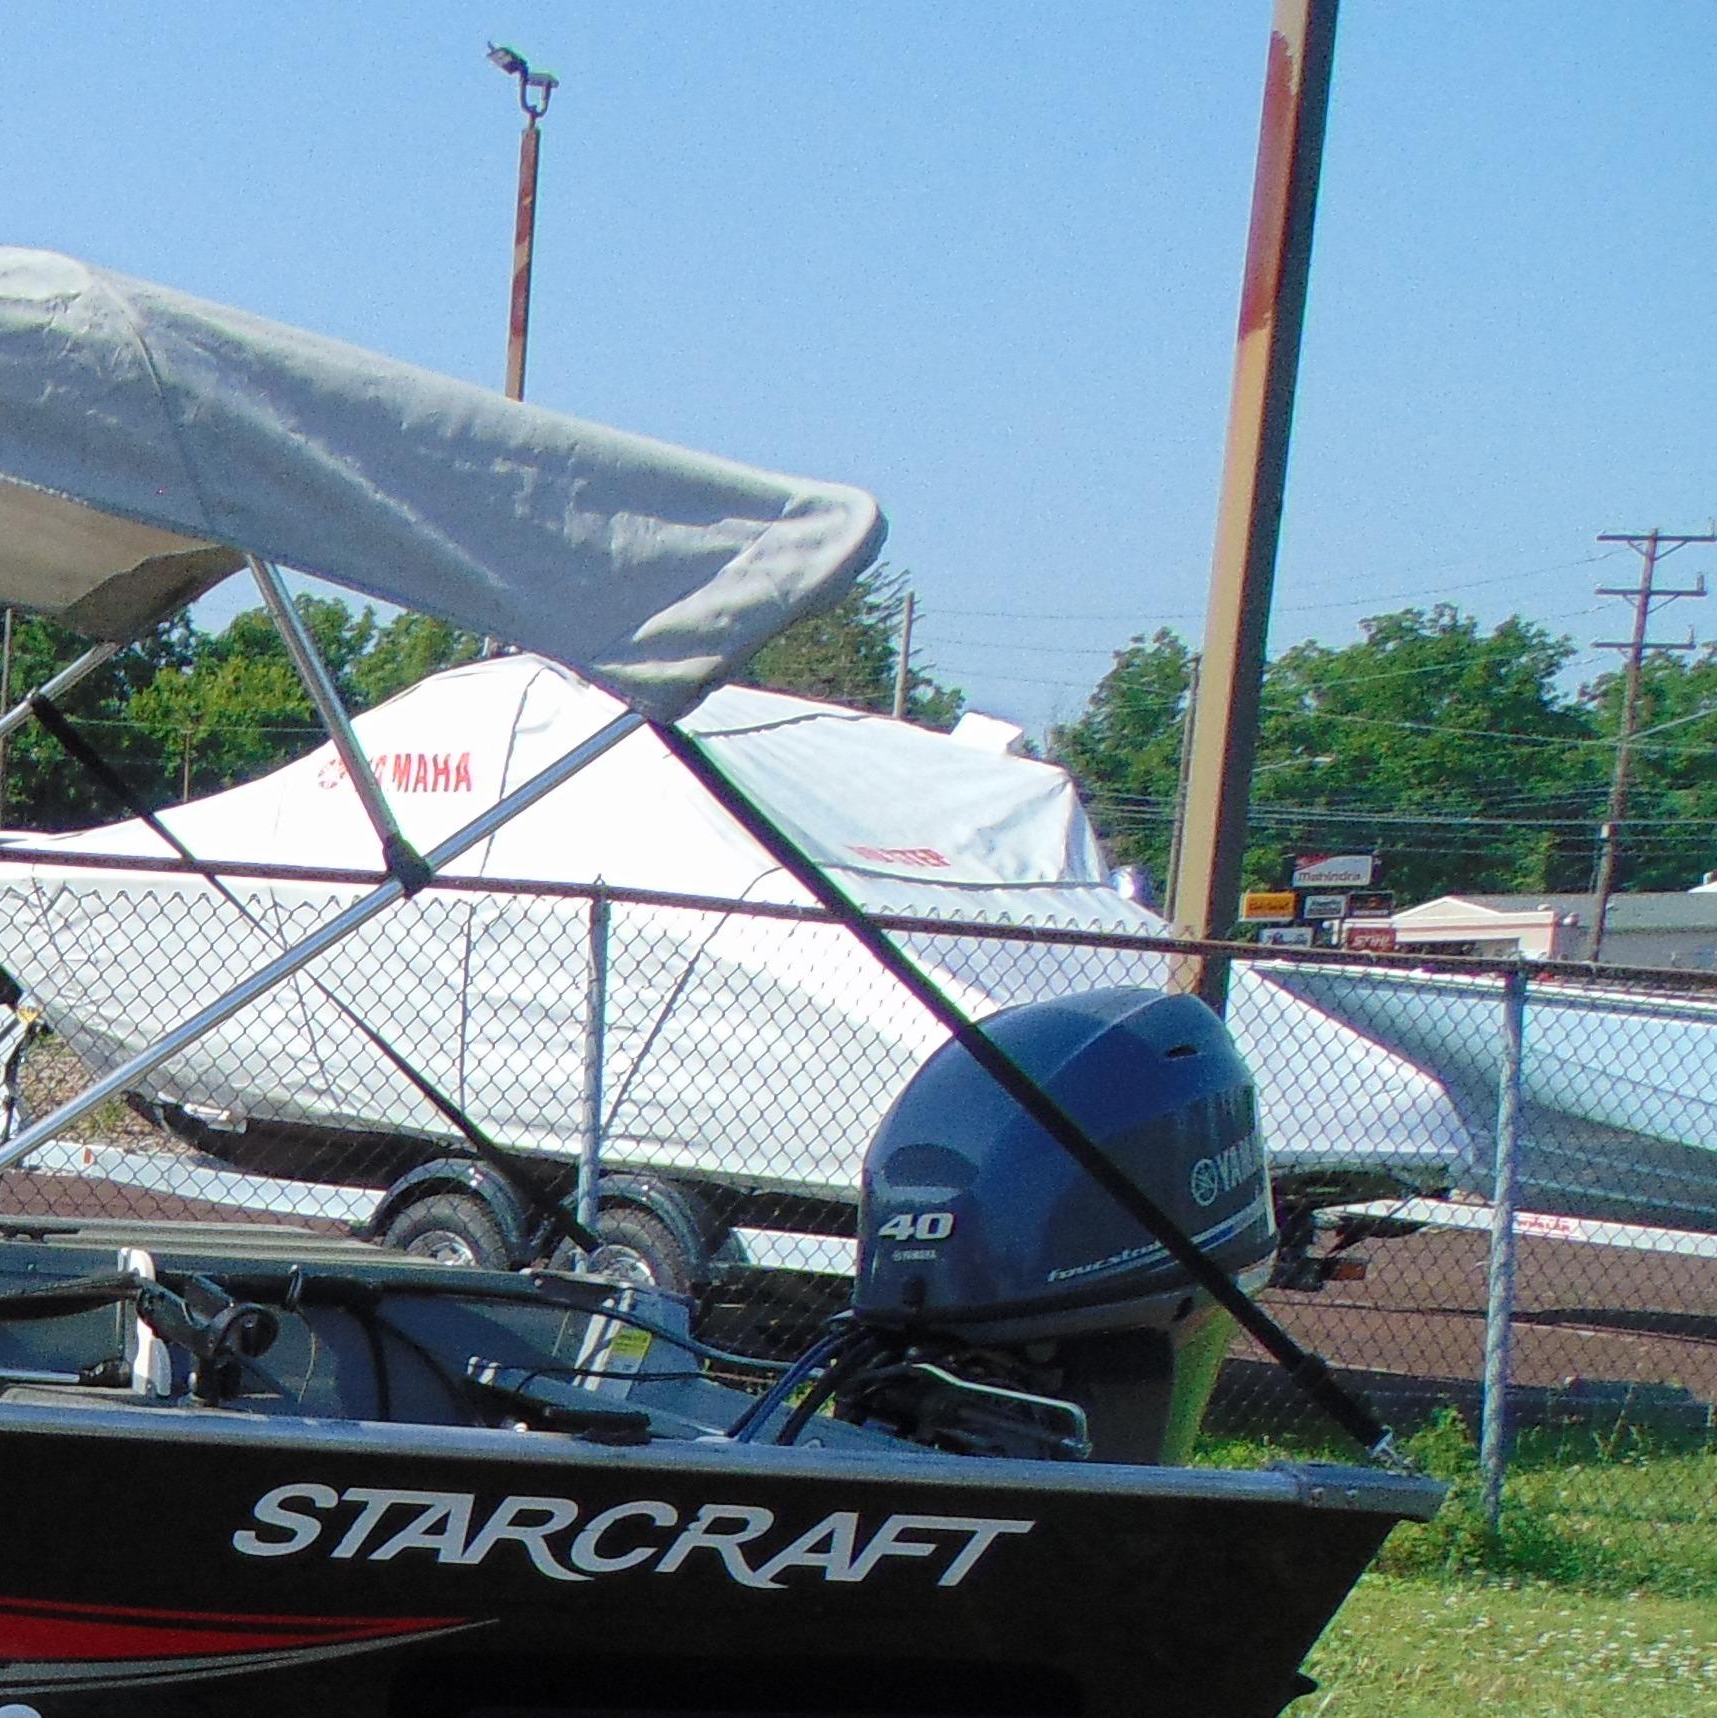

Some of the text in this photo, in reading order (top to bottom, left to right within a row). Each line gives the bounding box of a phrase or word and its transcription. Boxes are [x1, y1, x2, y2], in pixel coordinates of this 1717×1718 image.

[355, 752, 472, 793] AMAHA
[878, 1212, 954, 1241] 40
[231, 1482, 1037, 1589] STARCRAFT
